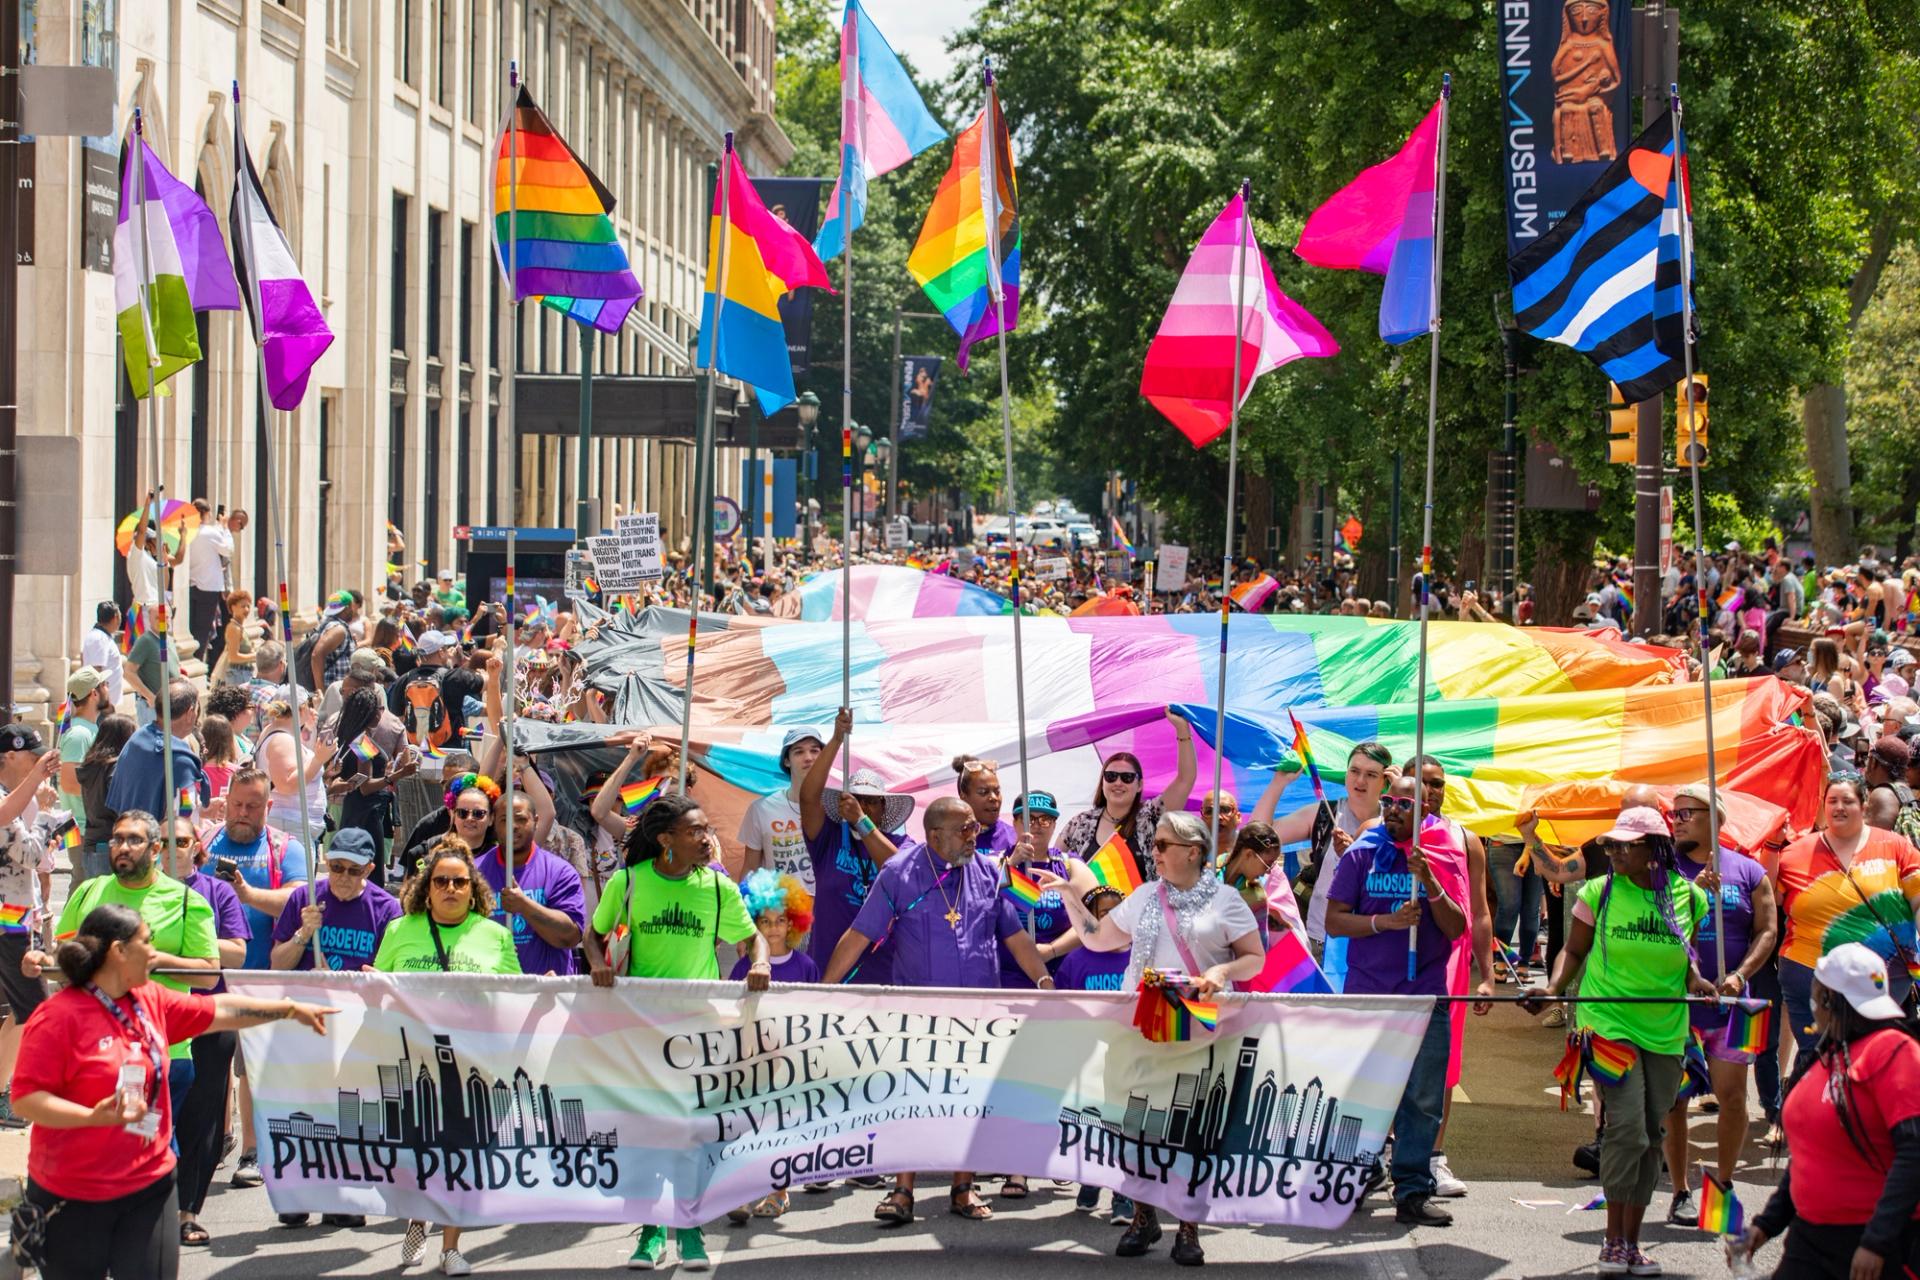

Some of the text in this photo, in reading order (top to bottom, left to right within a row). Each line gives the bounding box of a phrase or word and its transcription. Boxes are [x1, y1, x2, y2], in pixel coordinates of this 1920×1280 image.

[1504, 0, 1531, 67] ENN
[621, 526, 656, 537] DESTROYING
[631, 517, 645, 527] RICH
[646, 516, 657, 525] ARE
[621, 538, 632, 546] OUR
[621, 548, 656, 560] NOT TRANS
[1028, 797, 1051, 808] ANS
[771, 819, 798, 833] CA
[771, 834, 803, 847] KEE
[774, 856, 812, 874] FAC
[321, 925, 376, 953] OSOEVER
[663, 1011, 1018, 1070] CELEBRATING
[690, 1036, 994, 1110] PRIDE WITH
[712, 1067, 971, 1143] EVERYONE
[705, 1103, 995, 1170] A COMMUNITY PROGRAM OF
[270, 1132, 620, 1192] PHILLY PRIDE 365
[769, 1132, 877, 1190] galaei
[1058, 1121, 1178, 1185] PHILLY
[1187, 1152, 1302, 1199] PRIDE
